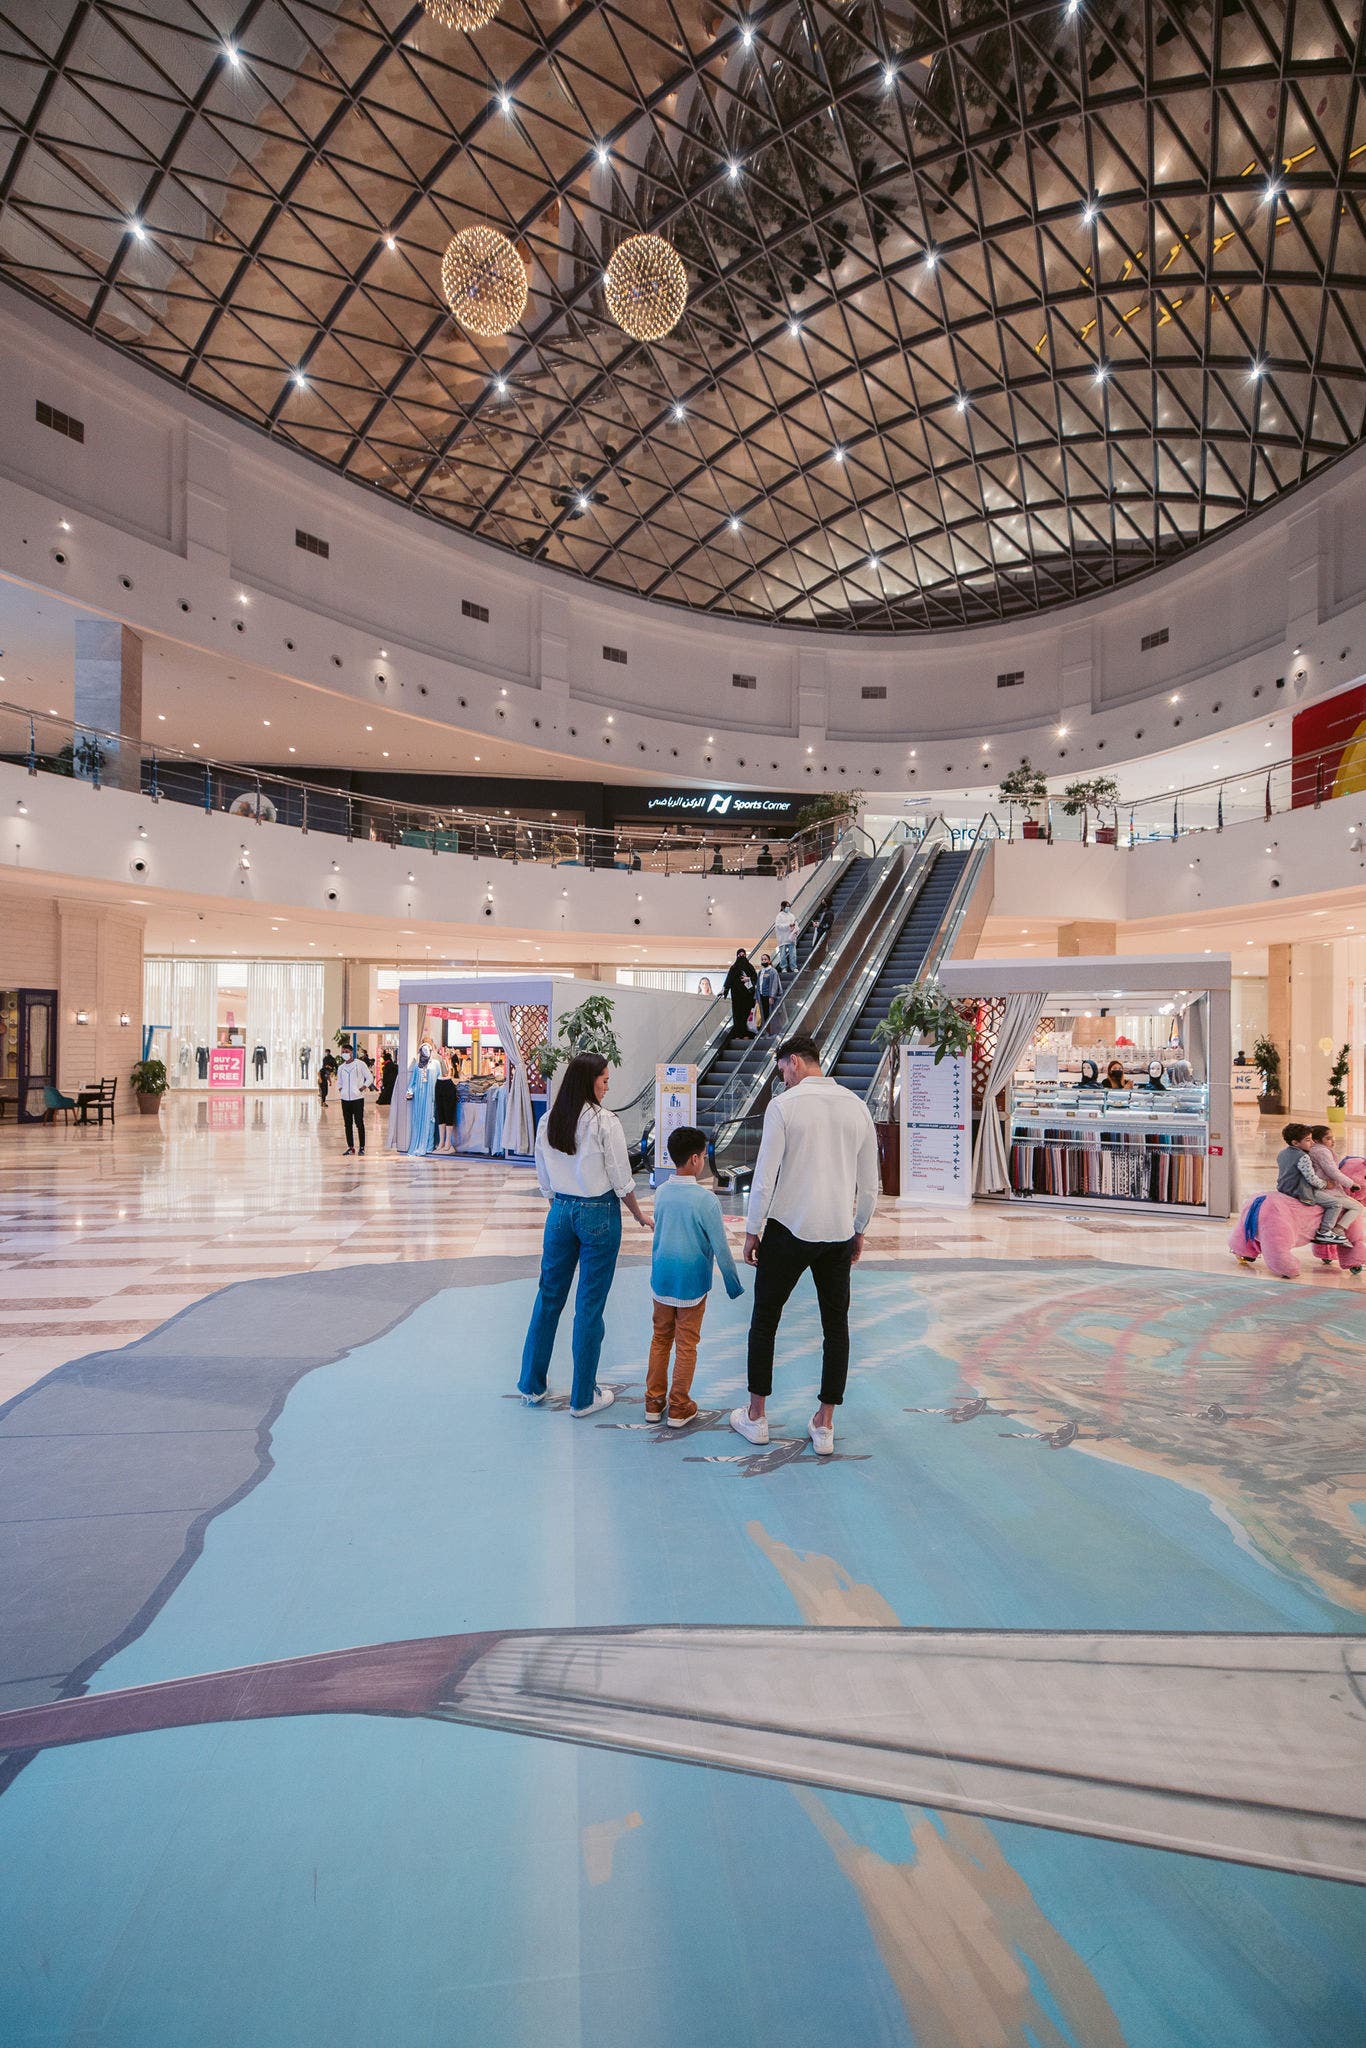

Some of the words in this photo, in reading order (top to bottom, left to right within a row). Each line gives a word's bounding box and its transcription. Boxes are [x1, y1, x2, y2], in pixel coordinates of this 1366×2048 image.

[648, 797, 682, 809] الرياضي
[682, 798, 706, 808] الركن
[733, 800, 762, 810] Sports
[762, 800, 791, 810] Corner
[230, 1057, 240, 1070] 2
[212, 1072, 240, 1080] FREE
